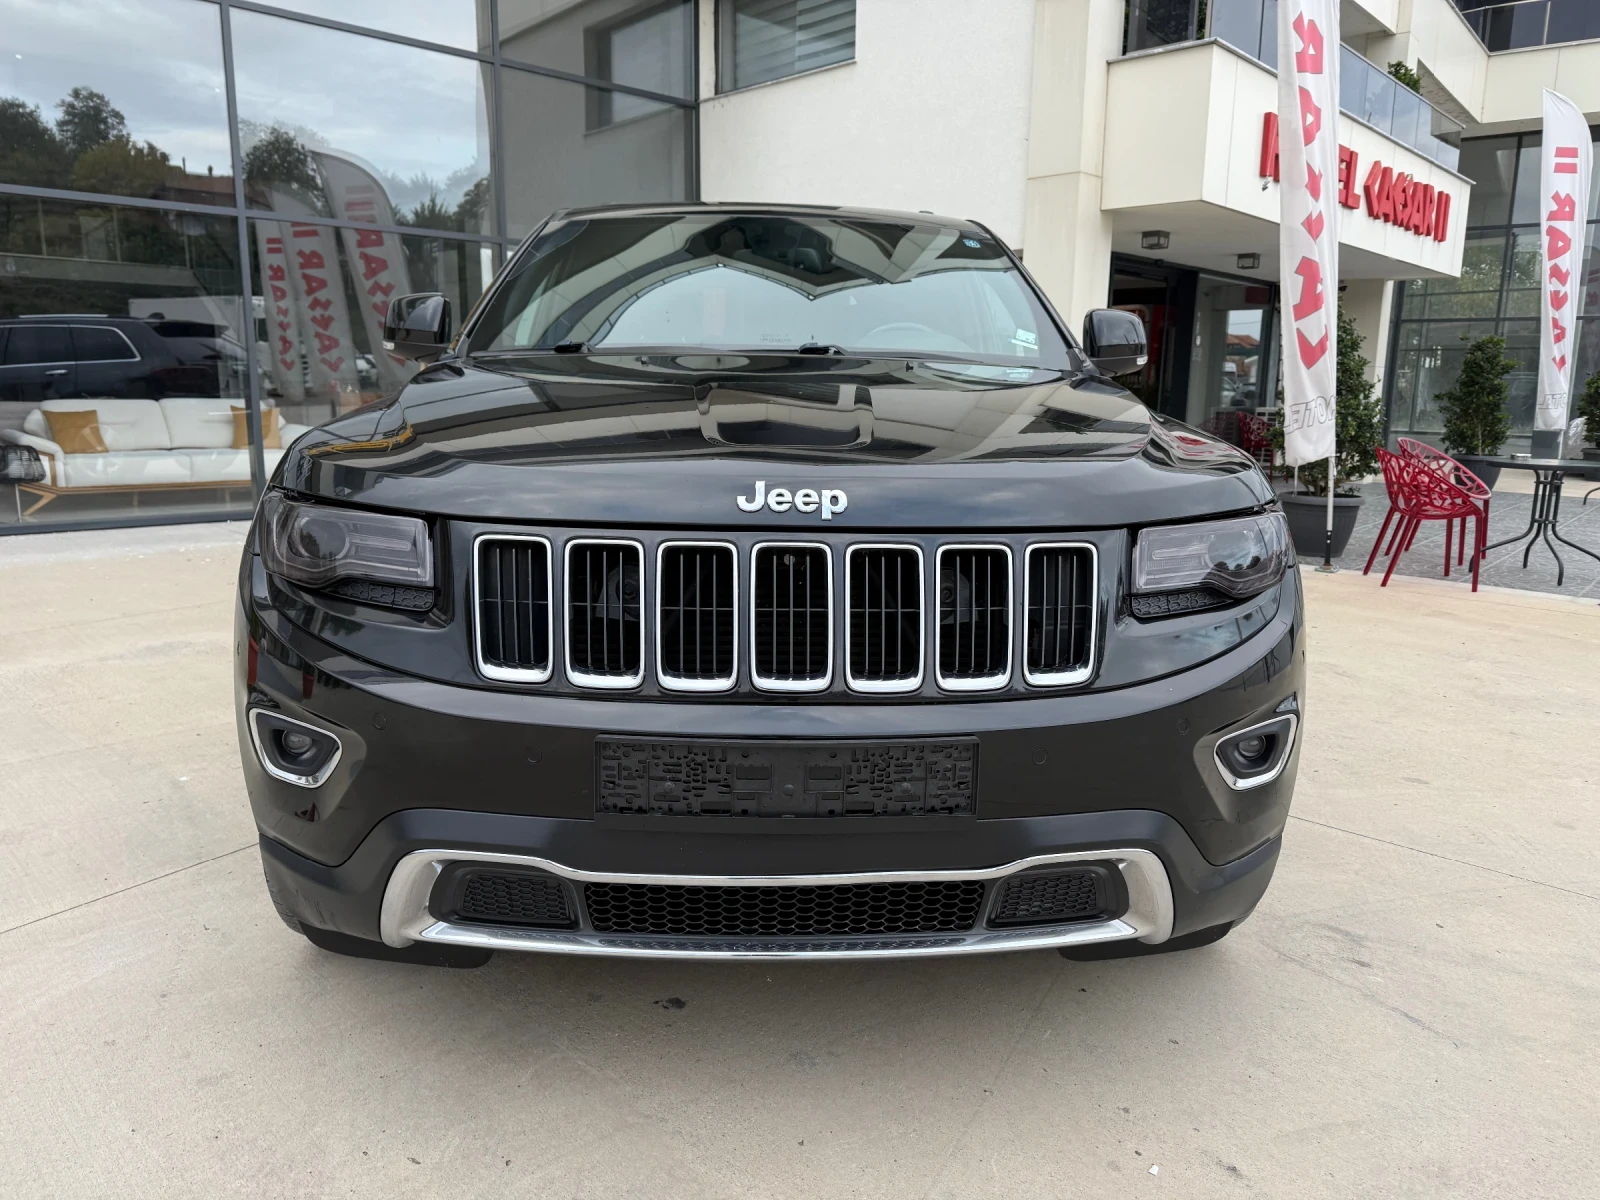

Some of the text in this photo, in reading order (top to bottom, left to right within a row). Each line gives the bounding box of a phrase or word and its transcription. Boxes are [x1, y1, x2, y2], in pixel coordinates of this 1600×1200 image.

[1259, 112, 1361, 209] HEL
[1364, 160, 1436, 237] CAESAR
[736, 480, 848, 521] Jeep
